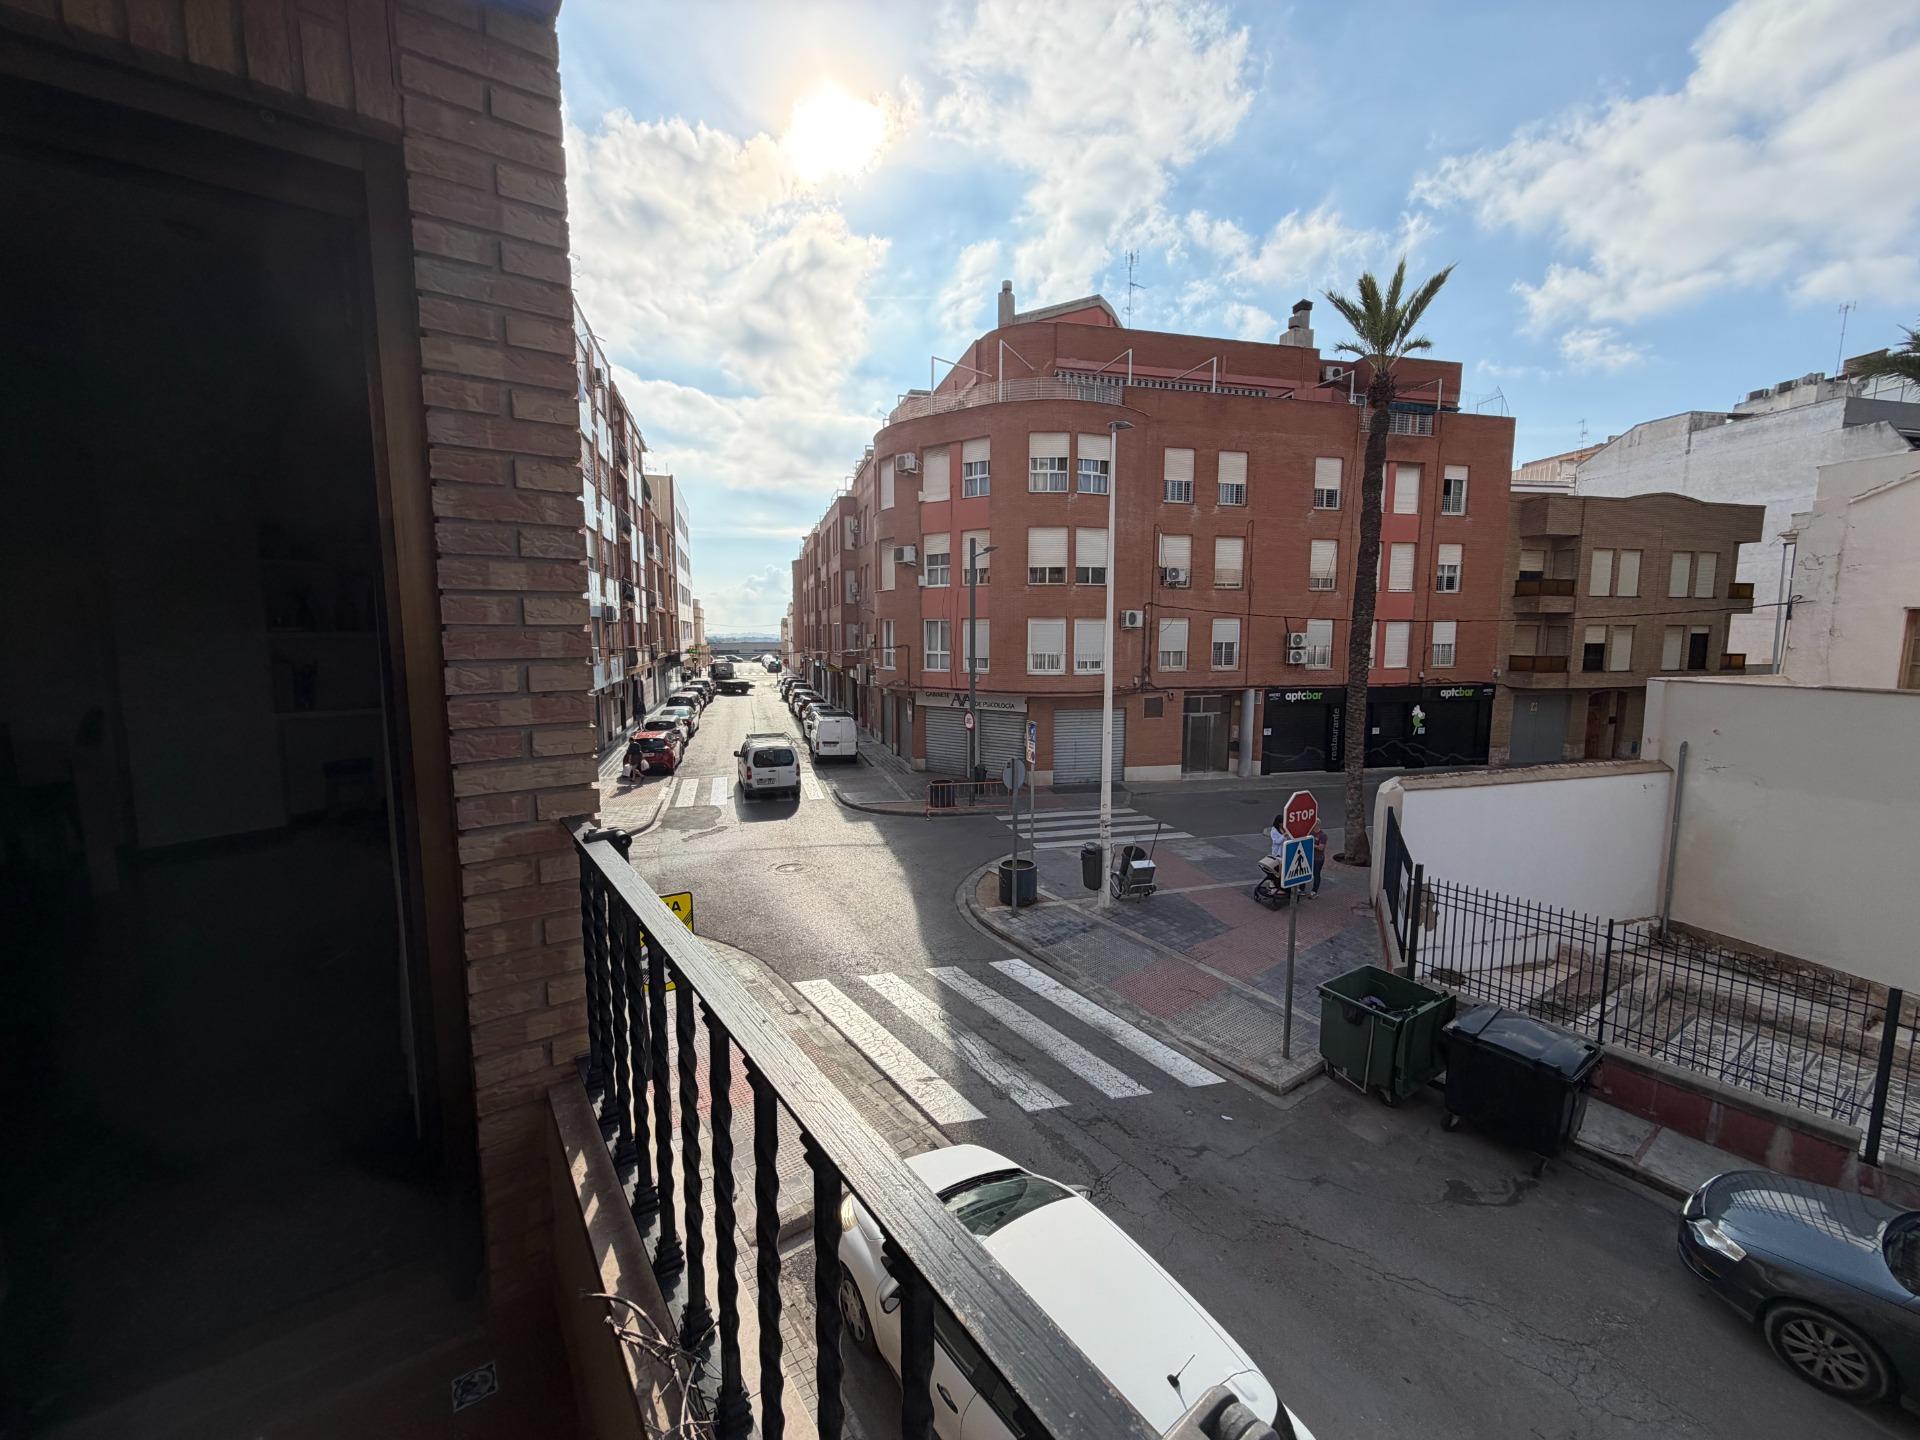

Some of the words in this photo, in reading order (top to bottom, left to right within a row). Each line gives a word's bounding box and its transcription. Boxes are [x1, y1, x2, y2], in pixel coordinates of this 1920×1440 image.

[1285, 690, 1323, 702] aptcbar
[1440, 687, 1474, 699] aptcbar
[1331, 707, 1340, 760] restaurante
[1289, 808, 1315, 823] STOP
